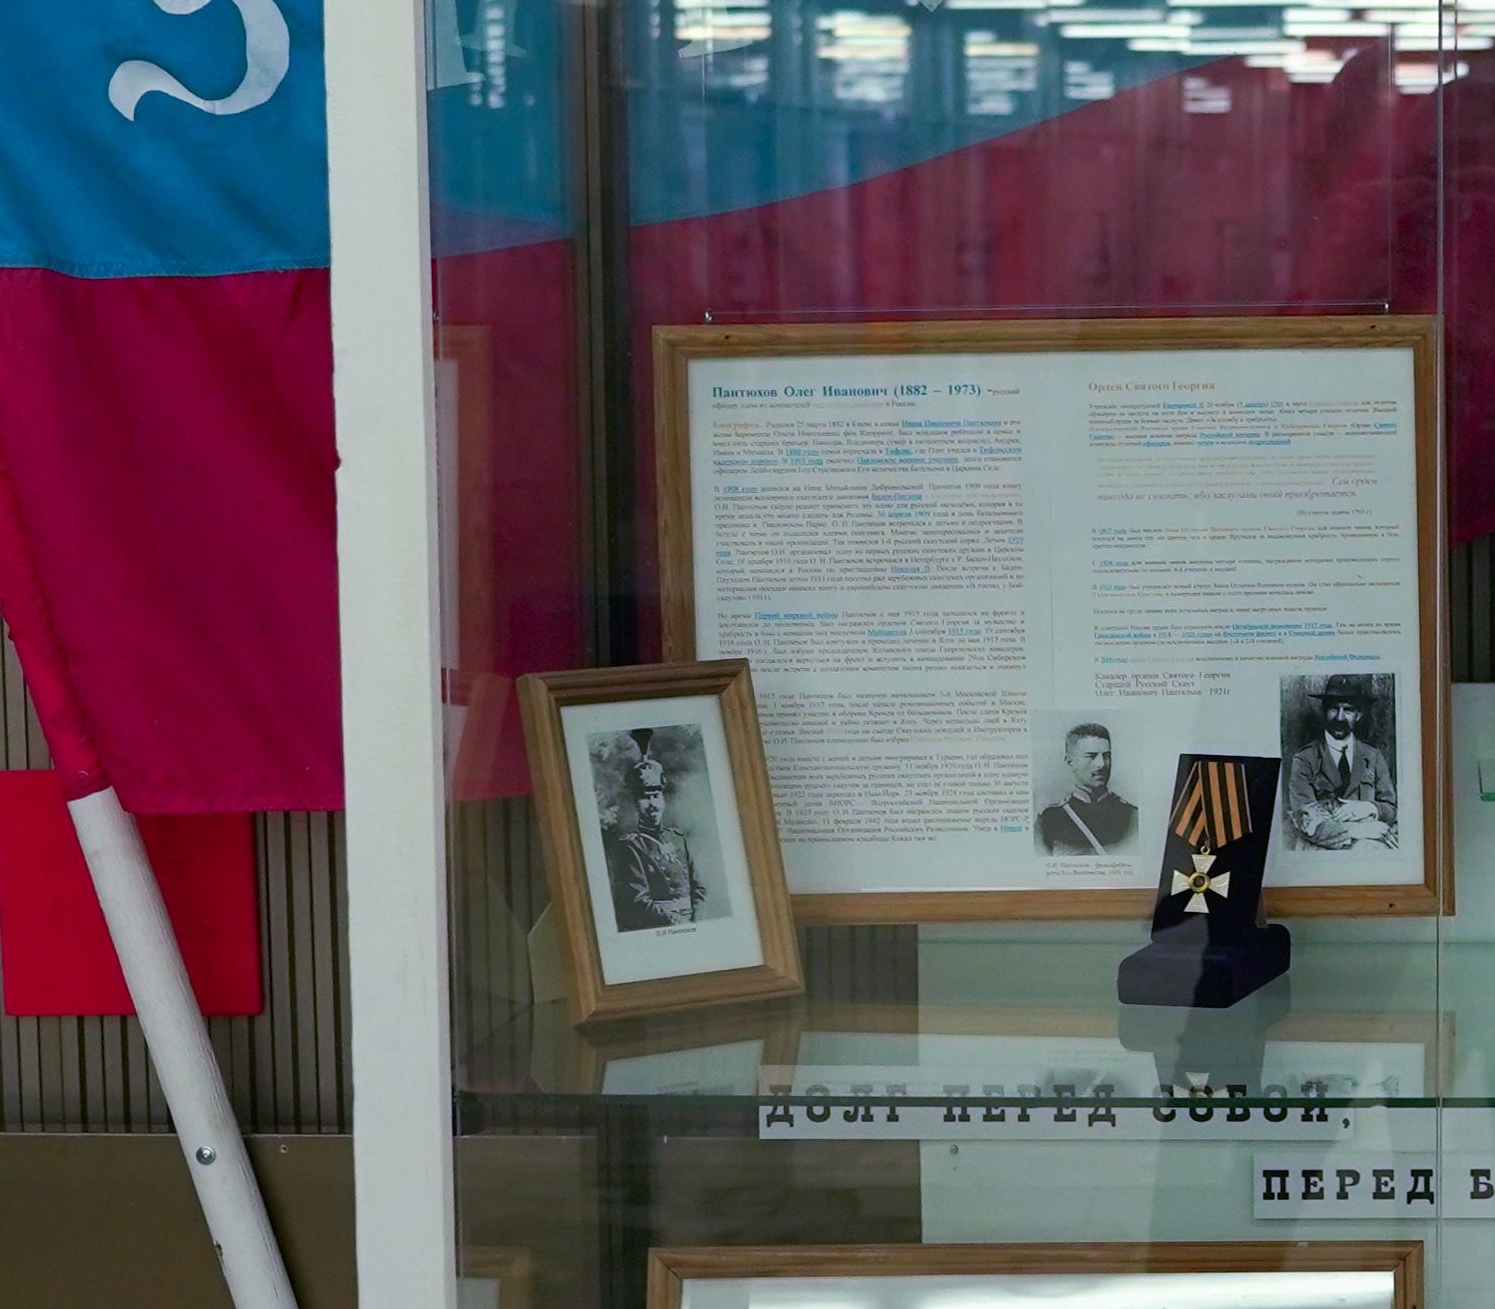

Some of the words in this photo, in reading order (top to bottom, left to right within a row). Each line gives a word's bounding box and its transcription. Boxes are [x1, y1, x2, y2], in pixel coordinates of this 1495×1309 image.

[712, 387, 778, 398] Пантюхов
[784, 386, 816, 397] Олег
[823, 386, 887, 396] Иванович
[892, 384, 927, 398] (1882
[949, 384, 981, 397] 1973)
[1260, 1170, 1438, 1204] ПЕРЕД
